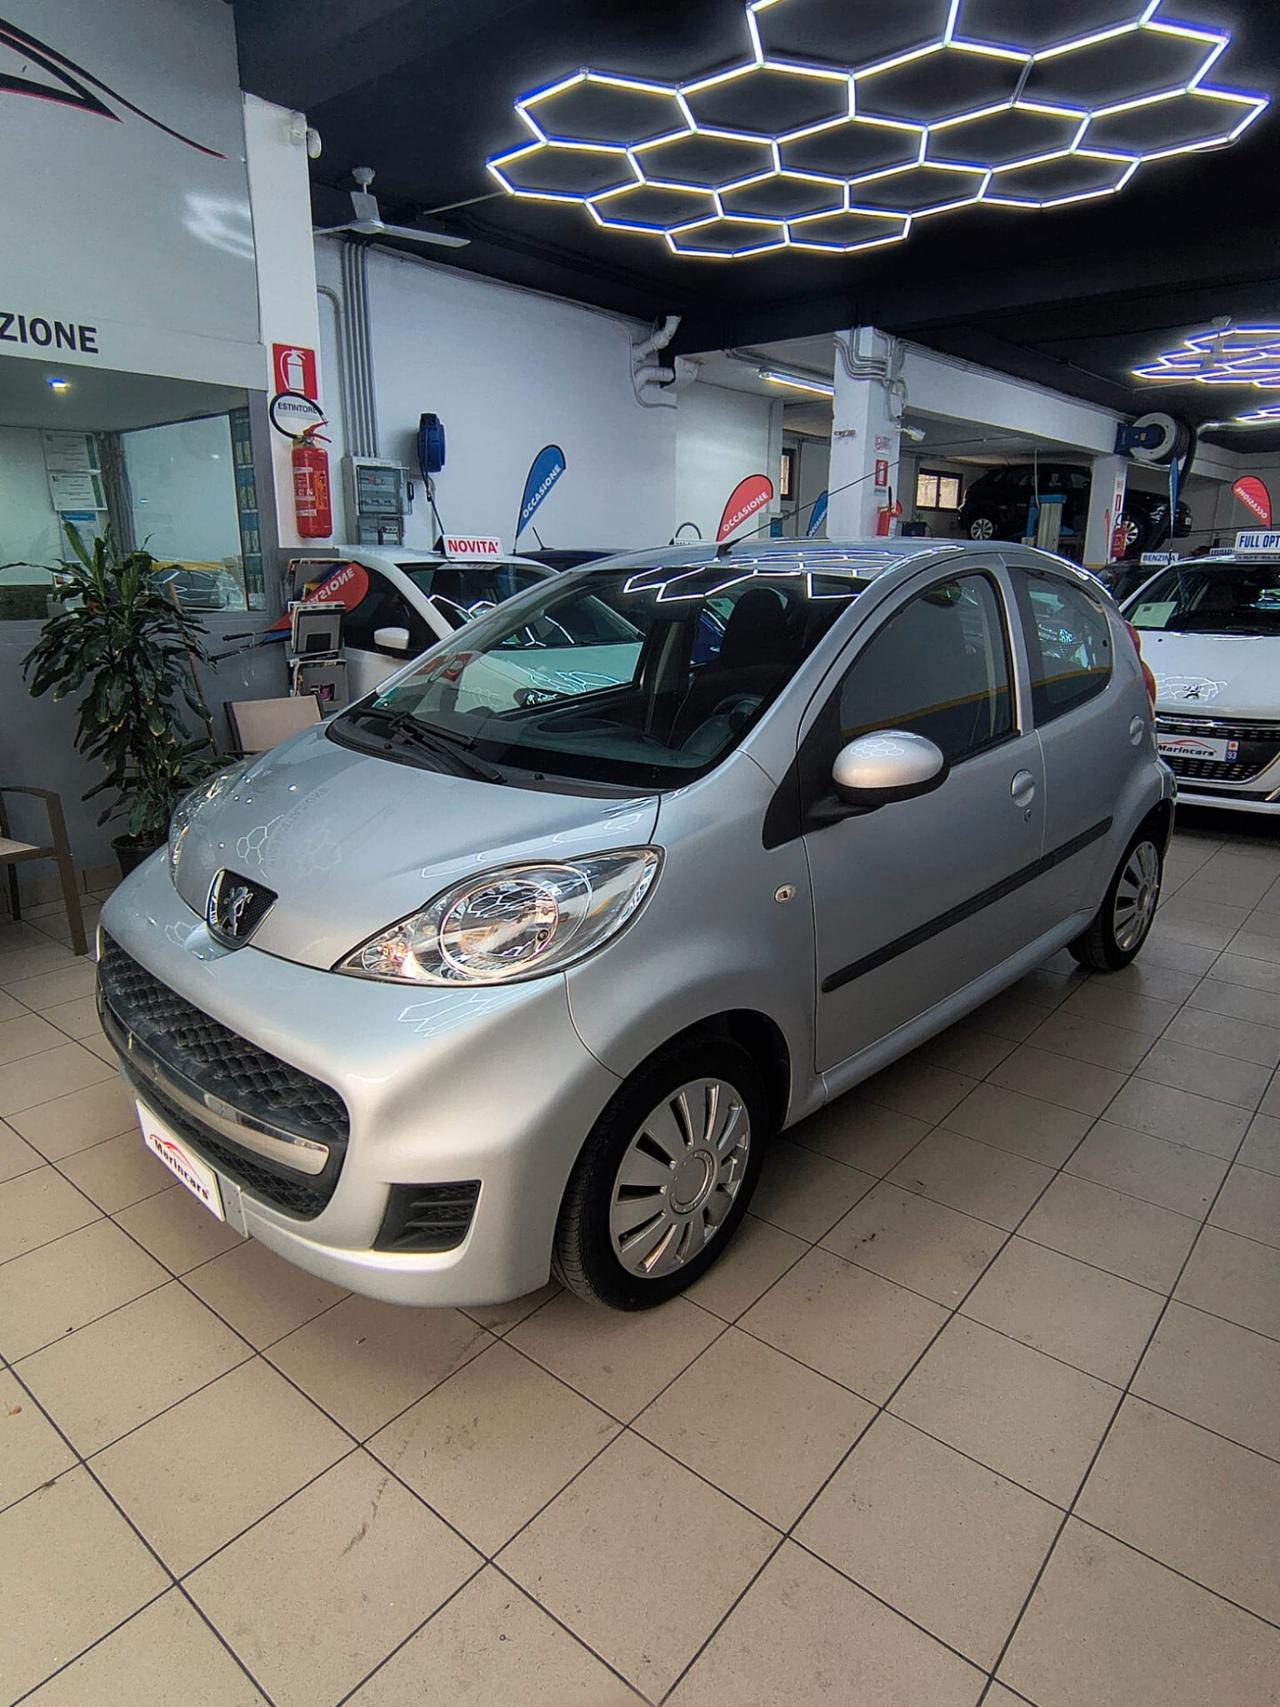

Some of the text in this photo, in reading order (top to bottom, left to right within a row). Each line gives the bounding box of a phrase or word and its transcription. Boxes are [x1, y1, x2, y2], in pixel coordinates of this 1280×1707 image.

[0, 312, 98, 354] ZIONE
[278, 402, 317, 414] ESTINTORE
[523, 464, 561, 518] OCCASIONE
[723, 492, 768, 531] OCCASIONE
[448, 540, 498, 553] NOVITA'
[1239, 535, 1260, 548] FULL
[1158, 744, 1214, 756] Marincars
[154, 1139, 208, 1200] Marincars
